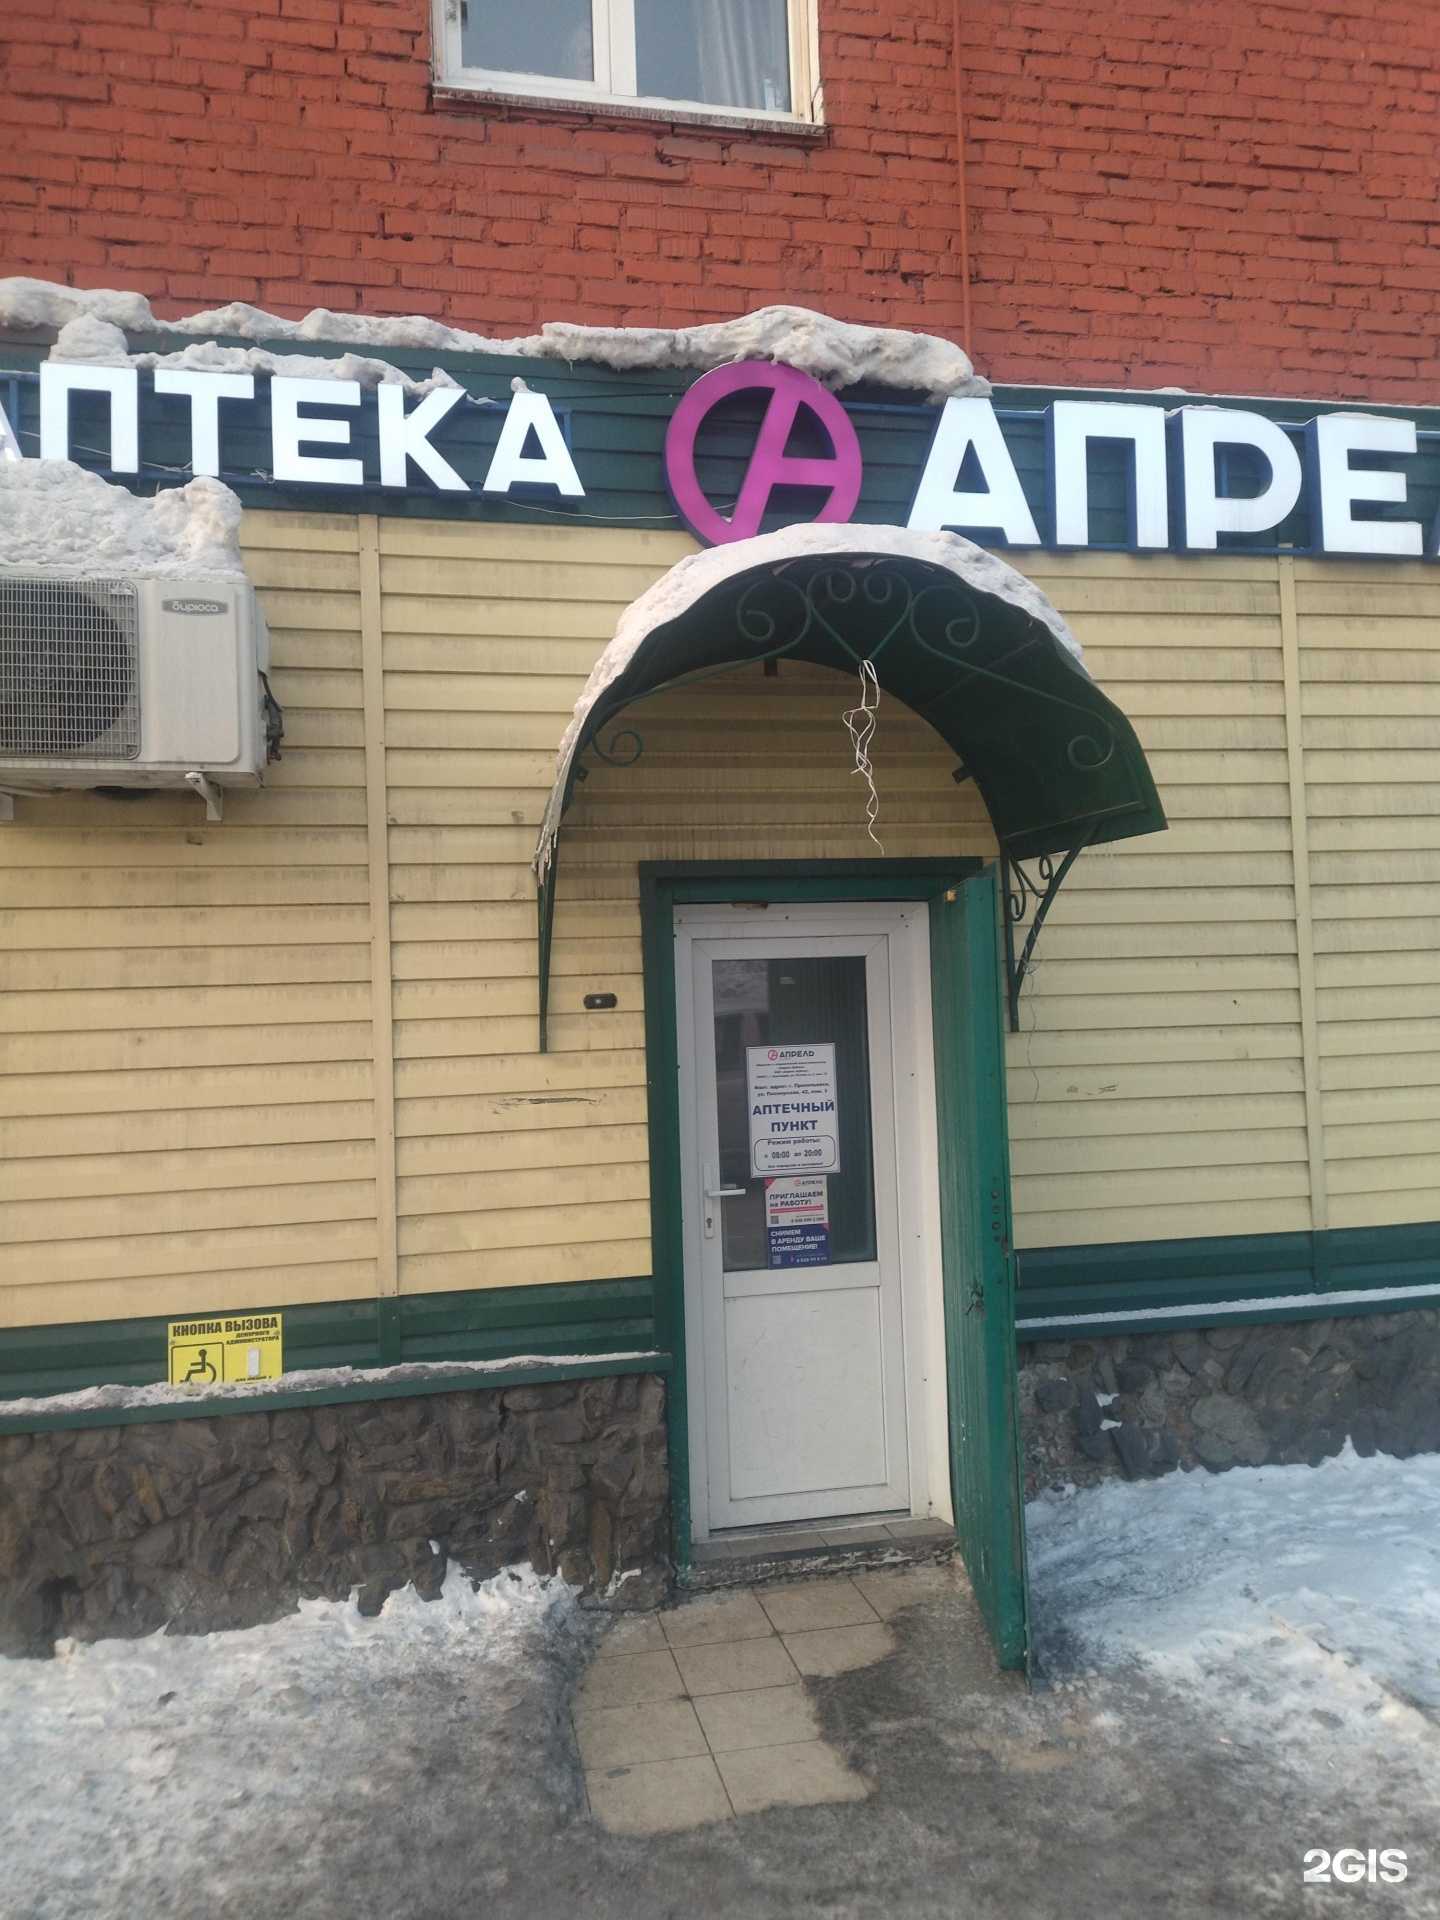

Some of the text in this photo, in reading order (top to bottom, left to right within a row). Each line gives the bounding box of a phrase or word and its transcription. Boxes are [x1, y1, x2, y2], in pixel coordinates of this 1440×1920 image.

[0, 361, 586, 496] ПТЕКА
[906, 396, 1440, 556] АПРЕ
[779, 1050, 815, 1058] АПРЕЛЬ
[752, 1100, 834, 1115] АПТЕЧНЫЙ
[771, 1120, 818, 1132] ПУНКТ
[804, 1149, 823, 1157] 20:00
[769, 1191, 823, 1200] ПРИГЛАШАЕМ
[172, 1317, 278, 1337] КНОПКА ВЫЗОВА
